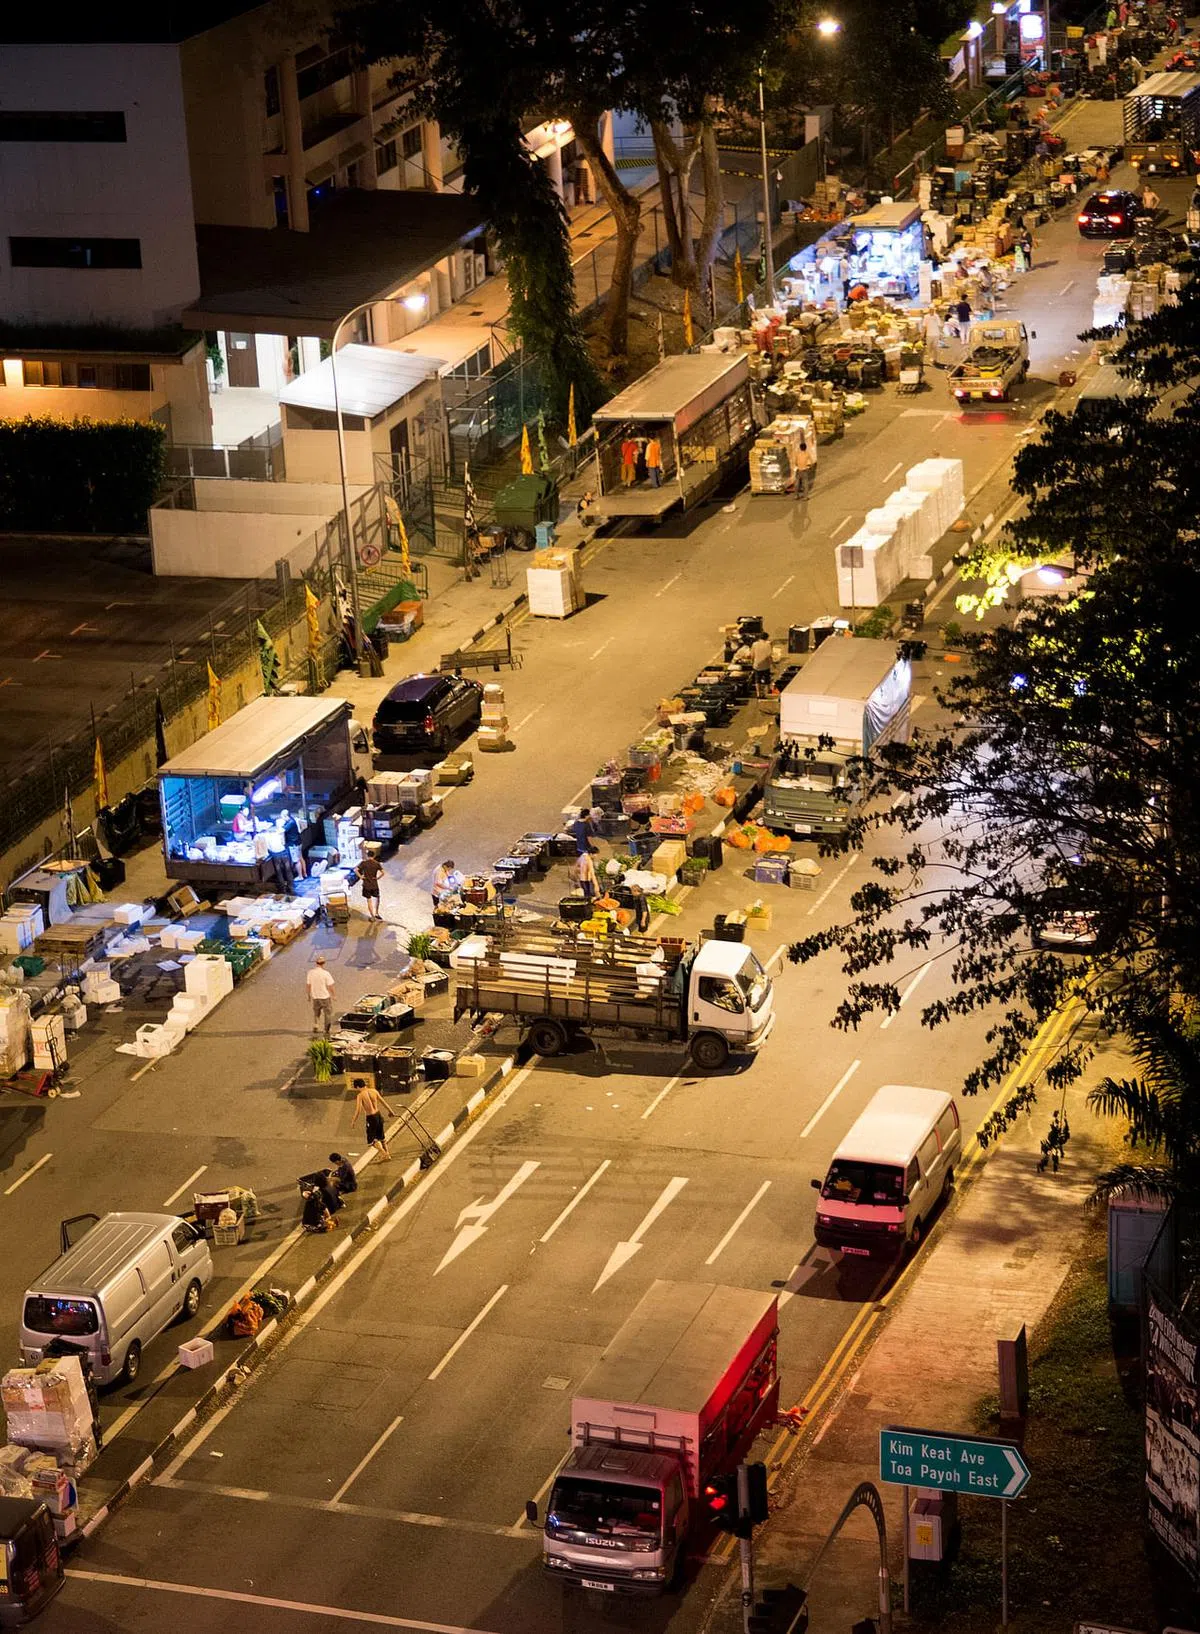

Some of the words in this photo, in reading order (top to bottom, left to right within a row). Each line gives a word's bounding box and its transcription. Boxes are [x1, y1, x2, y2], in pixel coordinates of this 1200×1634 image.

[890, 1440, 913, 1456] Kim
[921, 1444, 951, 1461] Keat
[960, 1450, 985, 1465] Ave
[890, 1461, 912, 1476] Toa
[920, 1464, 960, 1483] Payoh
[968, 1471, 998, 1488] East
[585, 1537, 616, 1547] ISUZU
